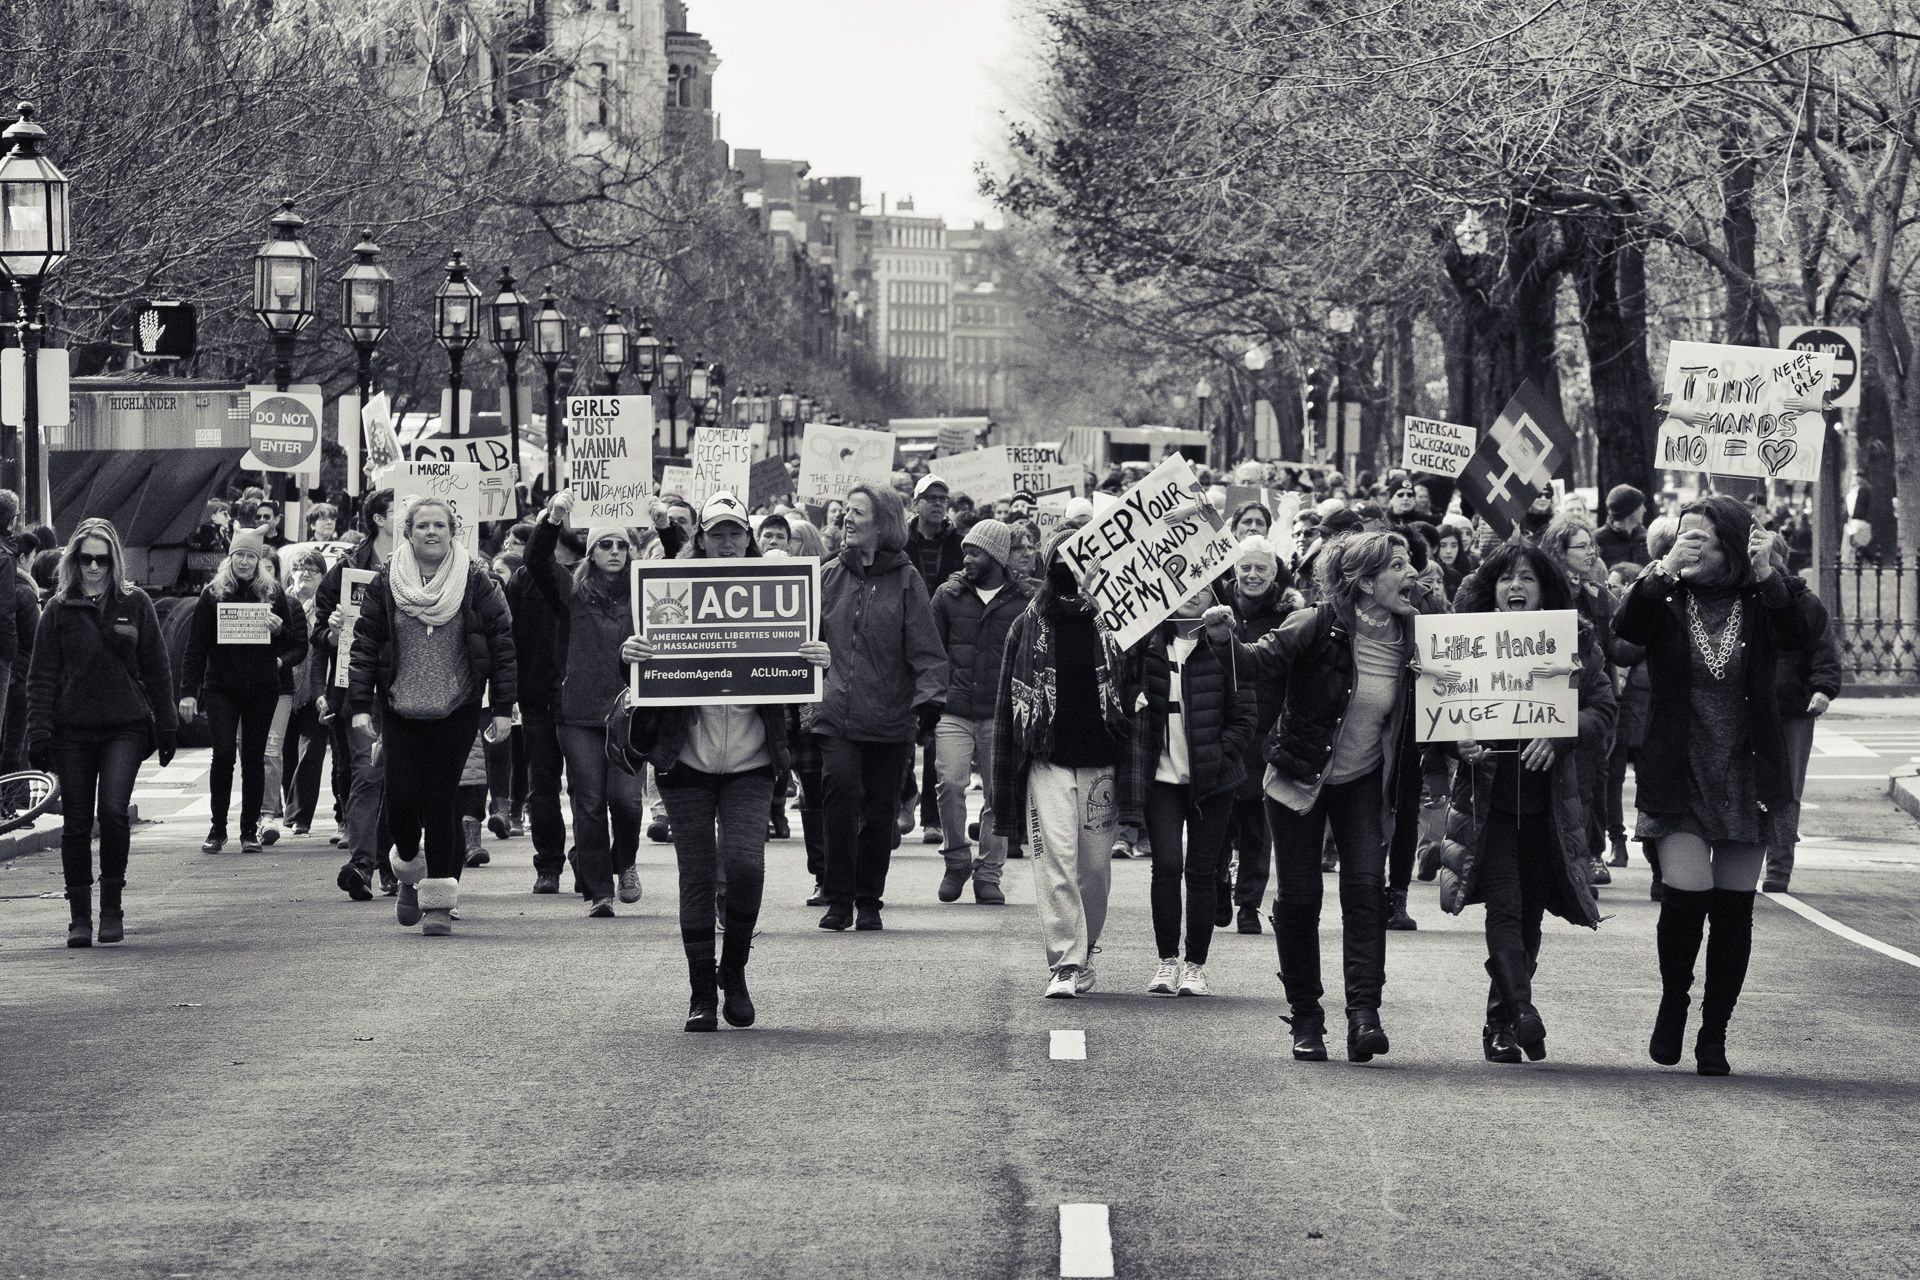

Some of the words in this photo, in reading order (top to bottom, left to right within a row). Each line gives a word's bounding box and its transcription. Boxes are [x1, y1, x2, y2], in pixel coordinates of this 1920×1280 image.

[1819, 344, 1845, 356] NOT
[1773, 353, 1818, 382] NEVER
[1794, 370, 1824, 397] PRES
[110, 397, 177, 410] HIGHLANDER
[571, 399, 621, 418] GIRLS
[255, 412, 275, 424] DO
[282, 412, 310, 425] NOT
[572, 418, 615, 436] JUST
[1701, 411, 1797, 439] HANDS
[696, 429, 750, 443] WOMEN'S
[1407, 418, 1462, 439] UNIVERSAL
[259, 440, 302, 454] ENTER
[571, 437, 628, 459] WANNA
[696, 445, 749, 463] RIGHTS
[1006, 447, 1058, 463] FREEDOM
[1409, 434, 1470, 458] BACKGROUND
[1664, 435, 1707, 466] NO
[417, 464, 451, 475] MARCH
[572, 460, 610, 480] HAVE
[695, 463, 723, 481] ARE
[1411, 453, 1457, 473] CHECKS
[809, 474, 829, 483] THE
[816, 484, 829, 495] IN
[591, 501, 634, 518] RIGHTS
[1066, 510, 1136, 575] KEEP
[1093, 557, 1144, 605] TINY
[1137, 520, 1199, 572] HANDS
[697, 584, 800, 620] ACLU
[1103, 592, 1137, 632] OFF
[1137, 577, 1170, 613] MY
[652, 632, 698, 641] AMERICAN
[700, 632, 723, 640] CIVIL
[724, 631, 770, 640] LIBERTIES
[772, 630, 801, 639] UNION
[1496, 630, 1557, 659] Hands
[664, 641, 737, 650] MASSACHUSETTS
[644, 669, 733, 681] #FreedomAgenda
[750, 667, 808, 680] ACLUm.org
[1491, 670, 1535, 692] Mind
